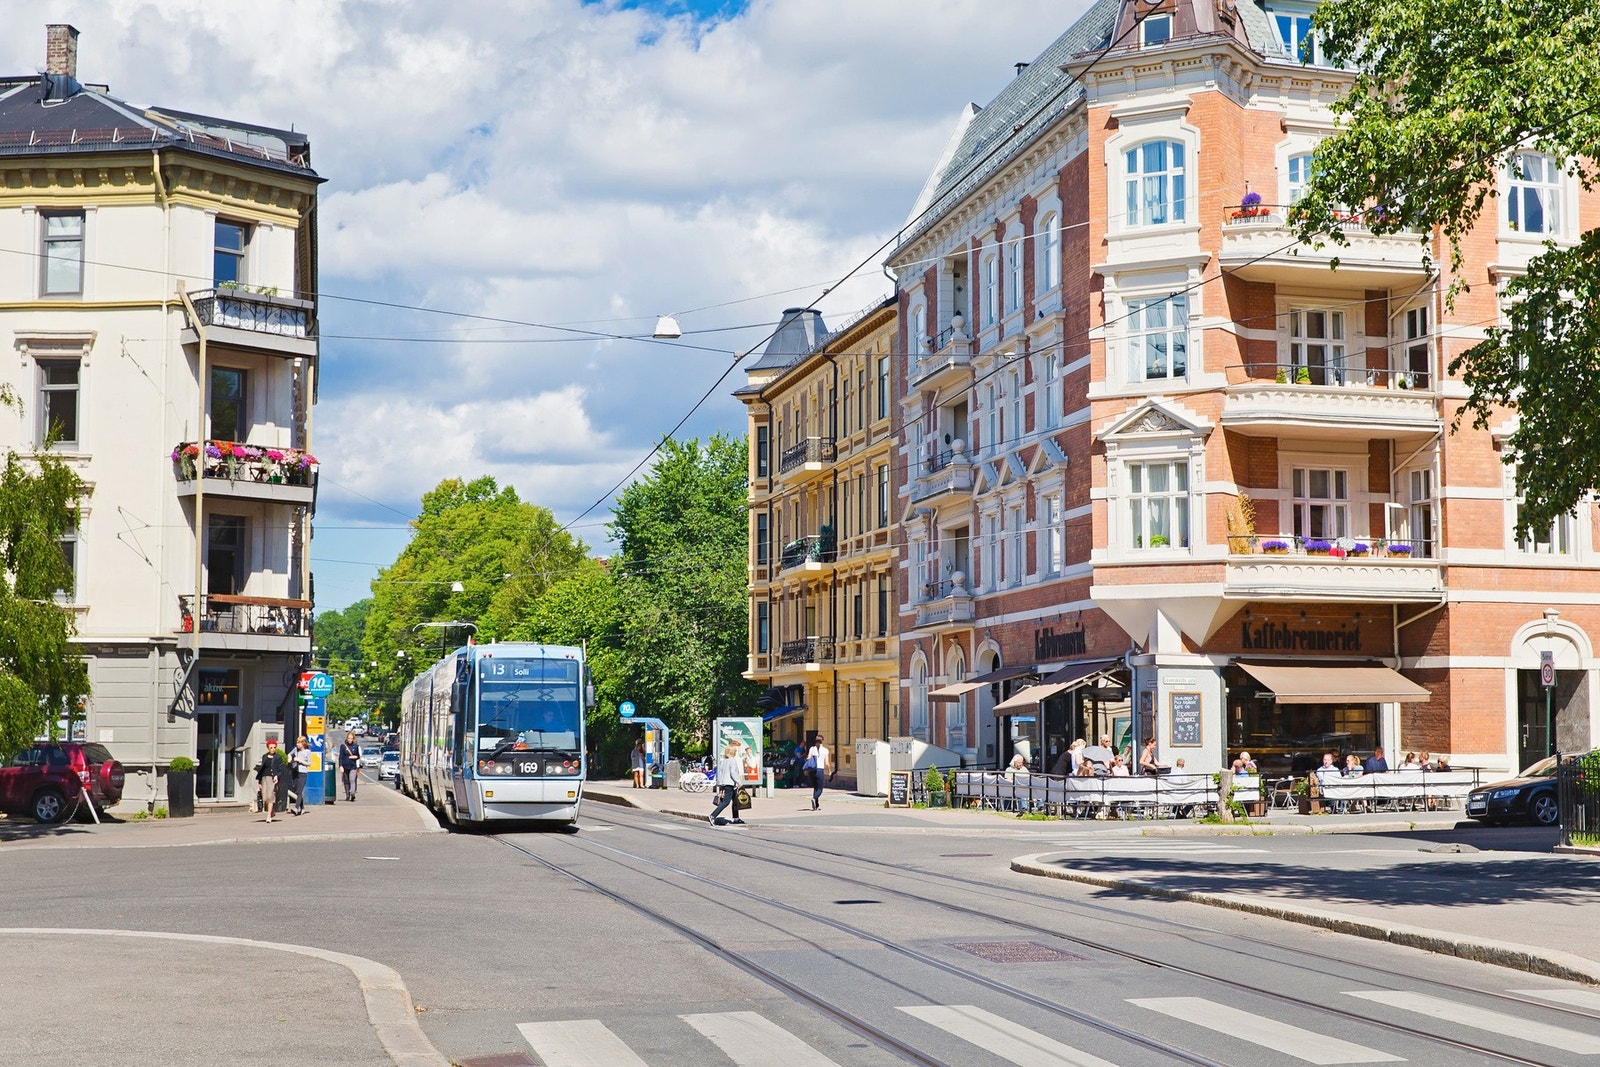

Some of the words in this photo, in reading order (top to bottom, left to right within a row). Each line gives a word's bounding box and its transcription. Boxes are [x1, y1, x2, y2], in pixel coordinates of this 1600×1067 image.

[1242, 621, 1361, 651] Kaffebrenneriet
[492, 664, 505, 675] 13
[514, 668, 529, 676] Solli
[312, 677, 326, 688] 10
[519, 762, 538, 773] 169
